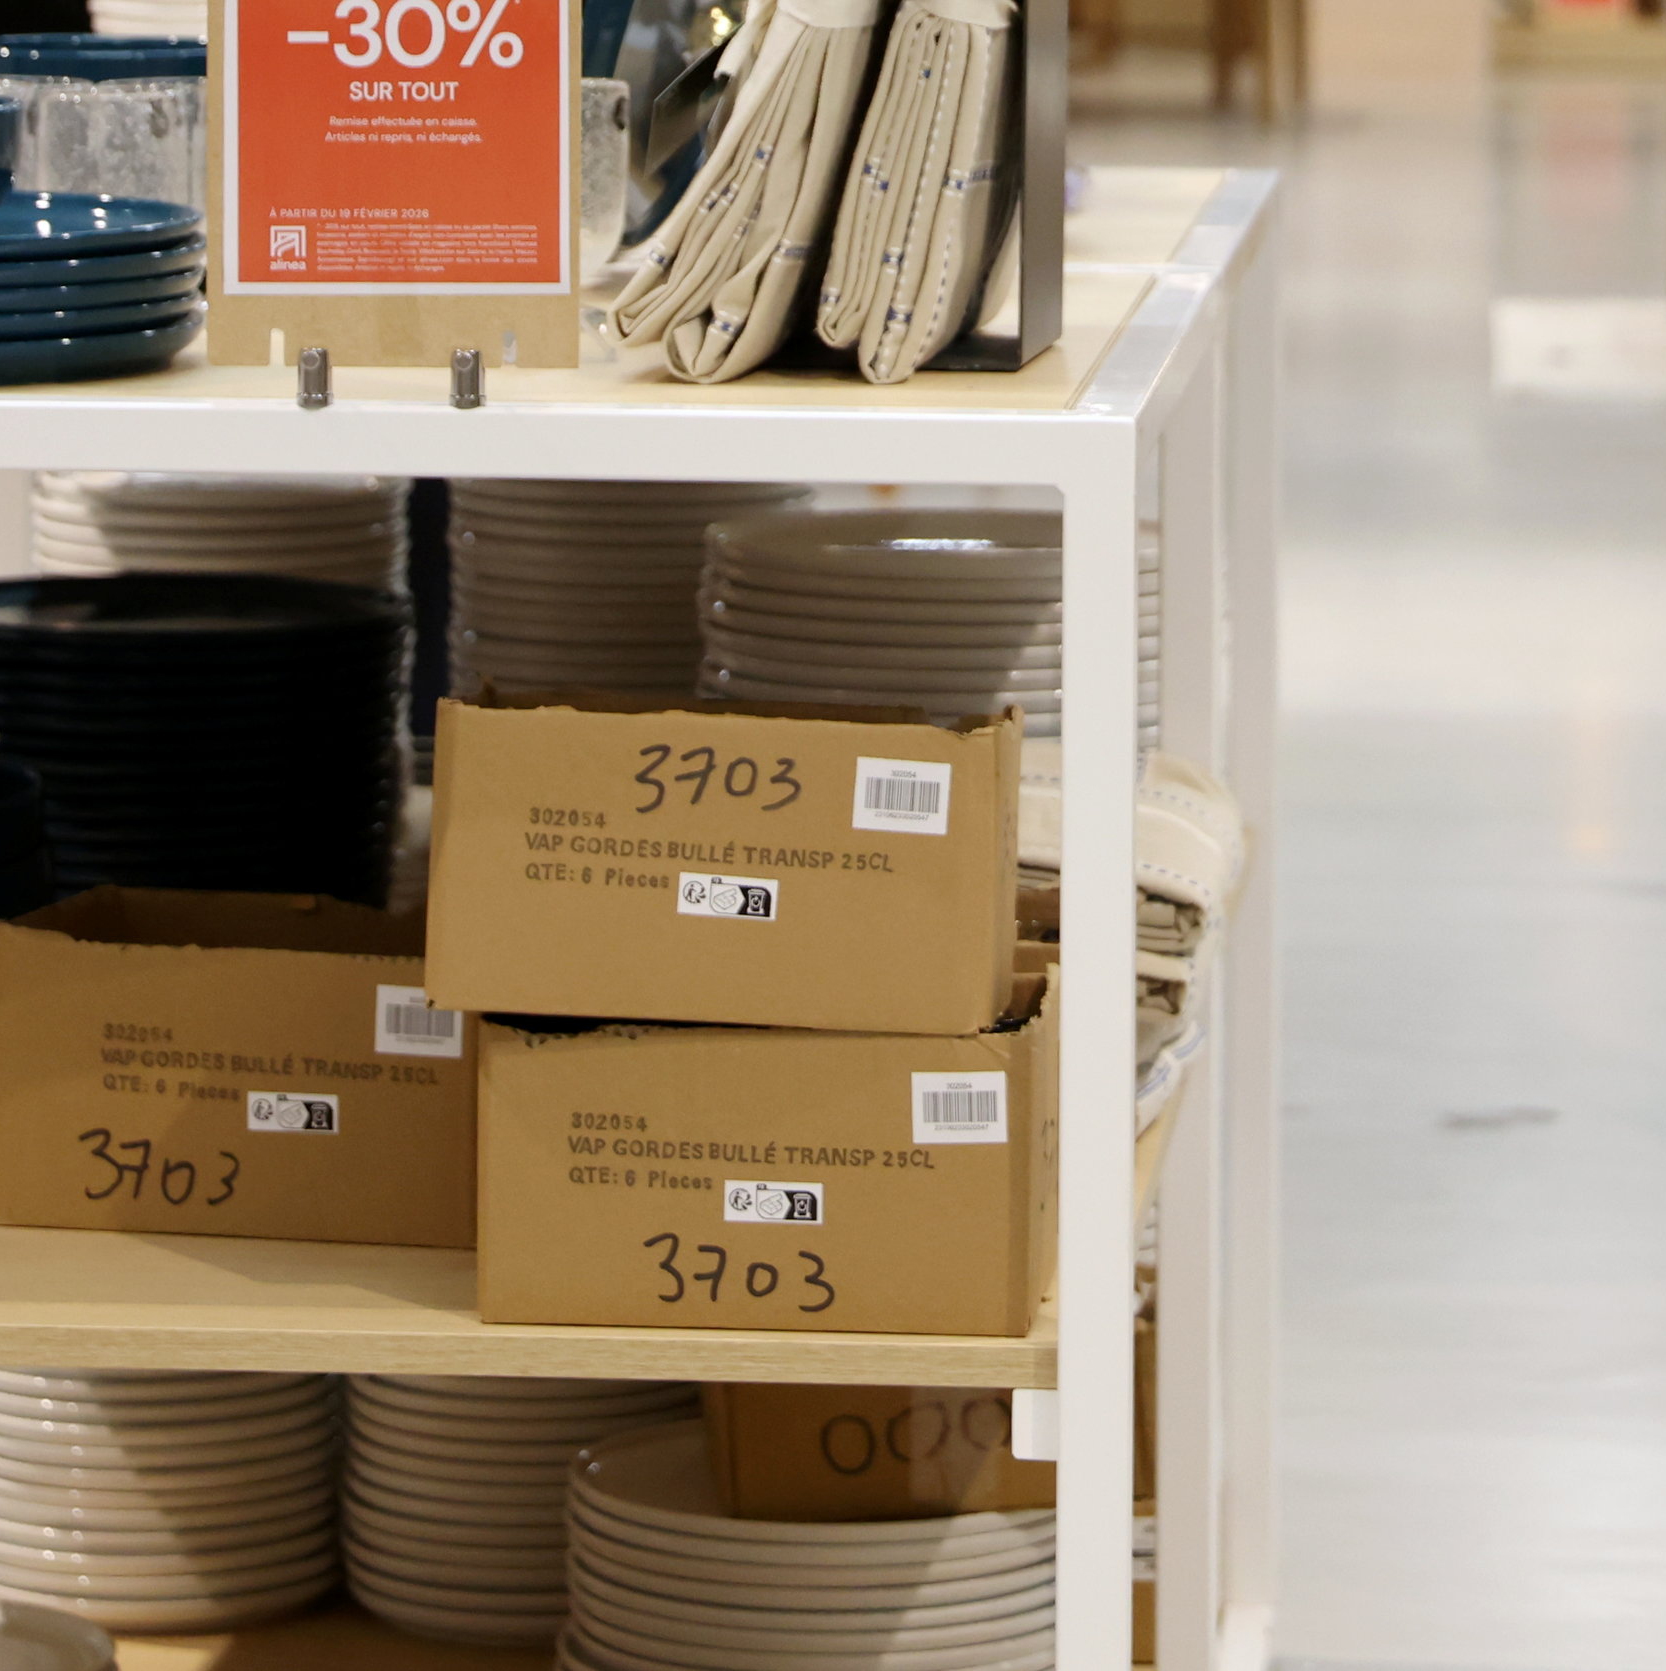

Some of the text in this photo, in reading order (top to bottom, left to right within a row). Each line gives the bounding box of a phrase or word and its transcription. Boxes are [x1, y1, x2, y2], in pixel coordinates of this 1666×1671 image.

[349, 81, 459, 102] SUR TOUT
[329, 115, 478, 127] Remise effectuée en caisse.
[325, 131, 483, 146] Articles ni repris, ni échangés.
[269, 206, 278, 218] À
[280, 208, 318, 218] PARTIR
[320, 208, 335, 218] DU
[353, 206, 398, 218] FÉVRIER
[400, 208, 430, 218] 2026
[270, 259, 307, 271] alinea
[634, 743, 802, 814] 3703
[529, 807, 607, 829] 302054
[524, 831, 895, 874] VAP GORDES BULLÉ TRANSP 25CL
[525, 863, 671, 890] QTE: 6 Pieces
[100, 1047, 135, 1067] VAP
[141, 1049, 226, 1072] GORDES
[231, 1052, 295, 1077] BULLÉ
[301, 1058, 383, 1082] TRANSP
[178, 1080, 241, 1102] Pieces
[570, 1111, 648, 1133] 302054
[567, 1135, 936, 1170] VAP GORDES BULLÉ TRANSP 25CL
[78, 1127, 241, 1206] 3703
[568, 1164, 714, 1191] QTE: 6 Pieces
[642, 1231, 836, 1313] 3703
